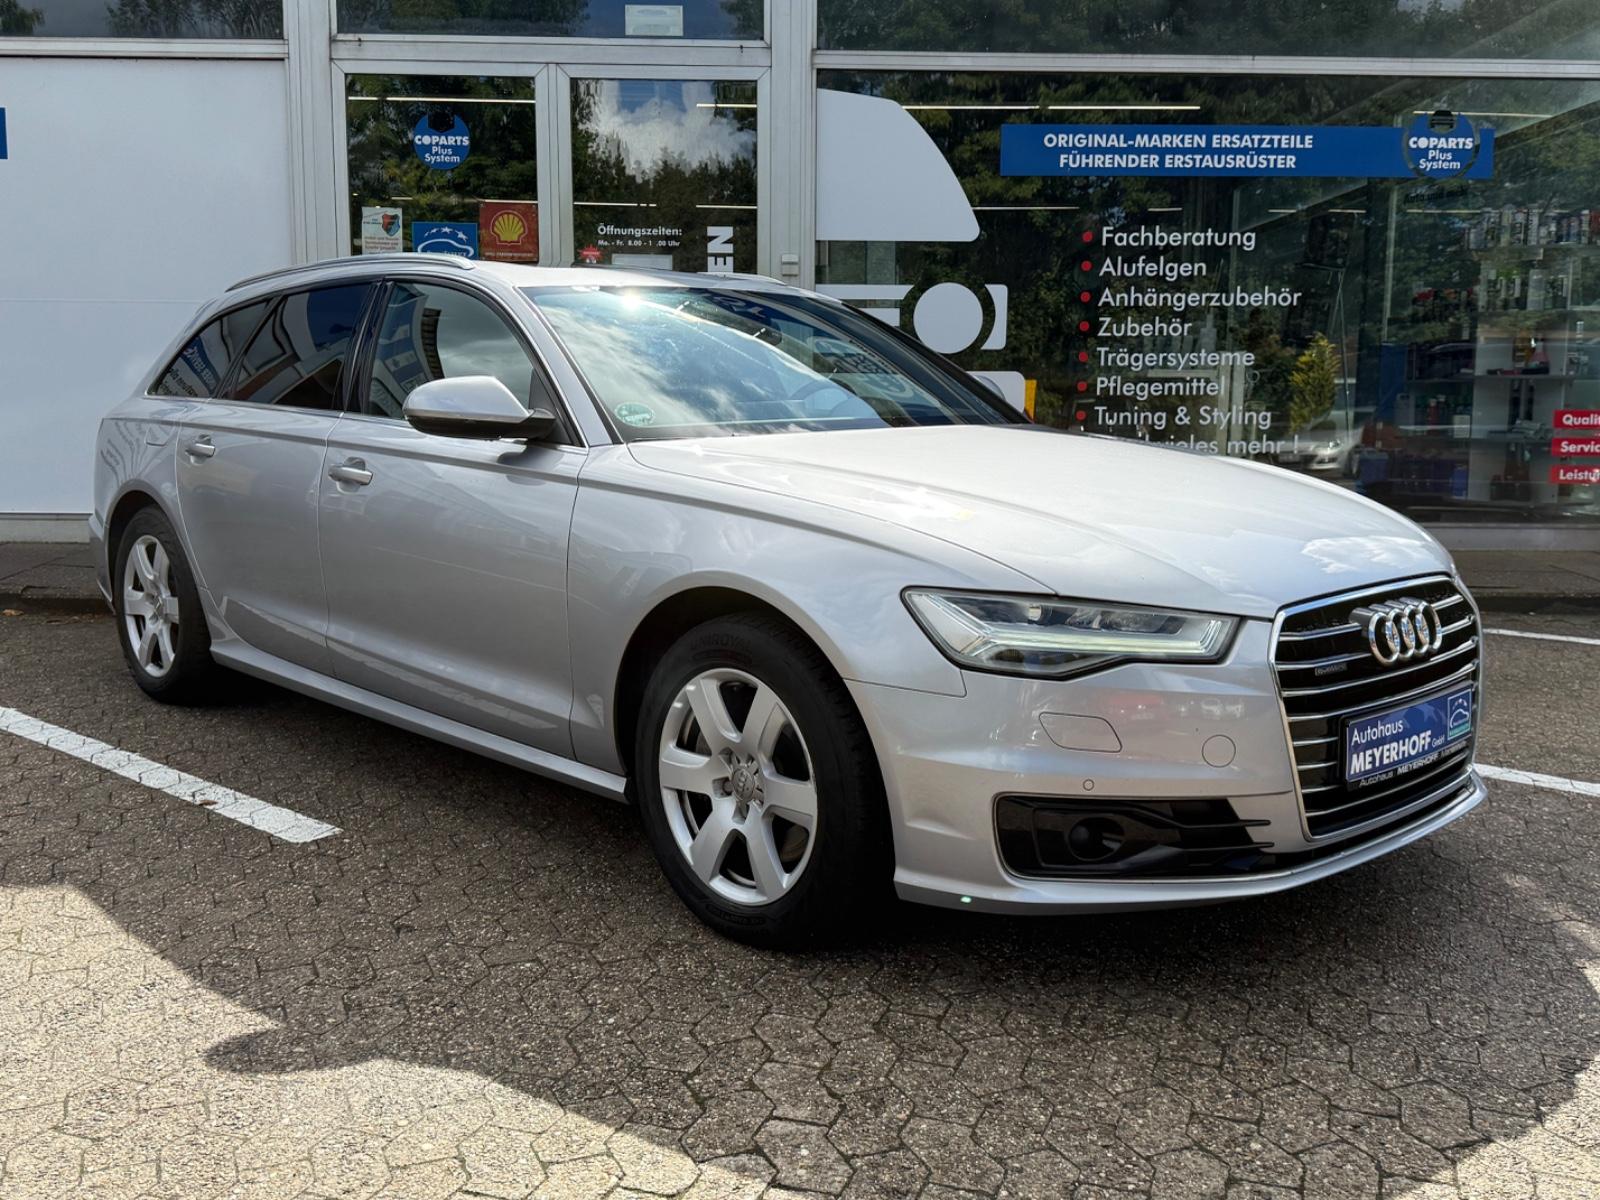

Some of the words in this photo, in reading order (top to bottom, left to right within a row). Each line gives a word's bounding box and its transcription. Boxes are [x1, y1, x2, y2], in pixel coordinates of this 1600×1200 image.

[414, 135, 470, 146] COPARTS
[431, 146, 453, 155] Plus
[1043, 133, 1206, 149] ORIGINAL-MARKEN
[1212, 134, 1314, 149] ERSATZTEILE
[1408, 136, 1474, 149] COPARTS
[424, 153, 460, 164] System
[1059, 150, 1160, 168] FÜHRENDER
[1164, 151, 1296, 168] ERSTAUSRÜSTER
[1419, 158, 1461, 171] System
[1428, 149, 1453, 160] Plus
[597, 223, 682, 237] Öffnungszeiten:
[1101, 225, 1256, 251] Fachberatung
[1098, 255, 1207, 281] Alufelgen
[1097, 286, 1302, 311] Anhängerzubehör
[1097, 316, 1192, 337] Zubehör
[1096, 347, 1255, 371] Trägersysteme
[1096, 376, 1225, 400] Pflegemittel
[1094, 405, 1167, 430] Tuning
[1175, 406, 1191, 426] &
[1199, 405, 1272, 430] Styling
[1227, 434, 1285, 454] mehr
[1351, 720, 1404, 746] Autohaus
[1350, 730, 1432, 775] MEYERHOFF
[1359, 772, 1394, 788] Autohaus
[1397, 753, 1439, 775] MEYERHOFF
